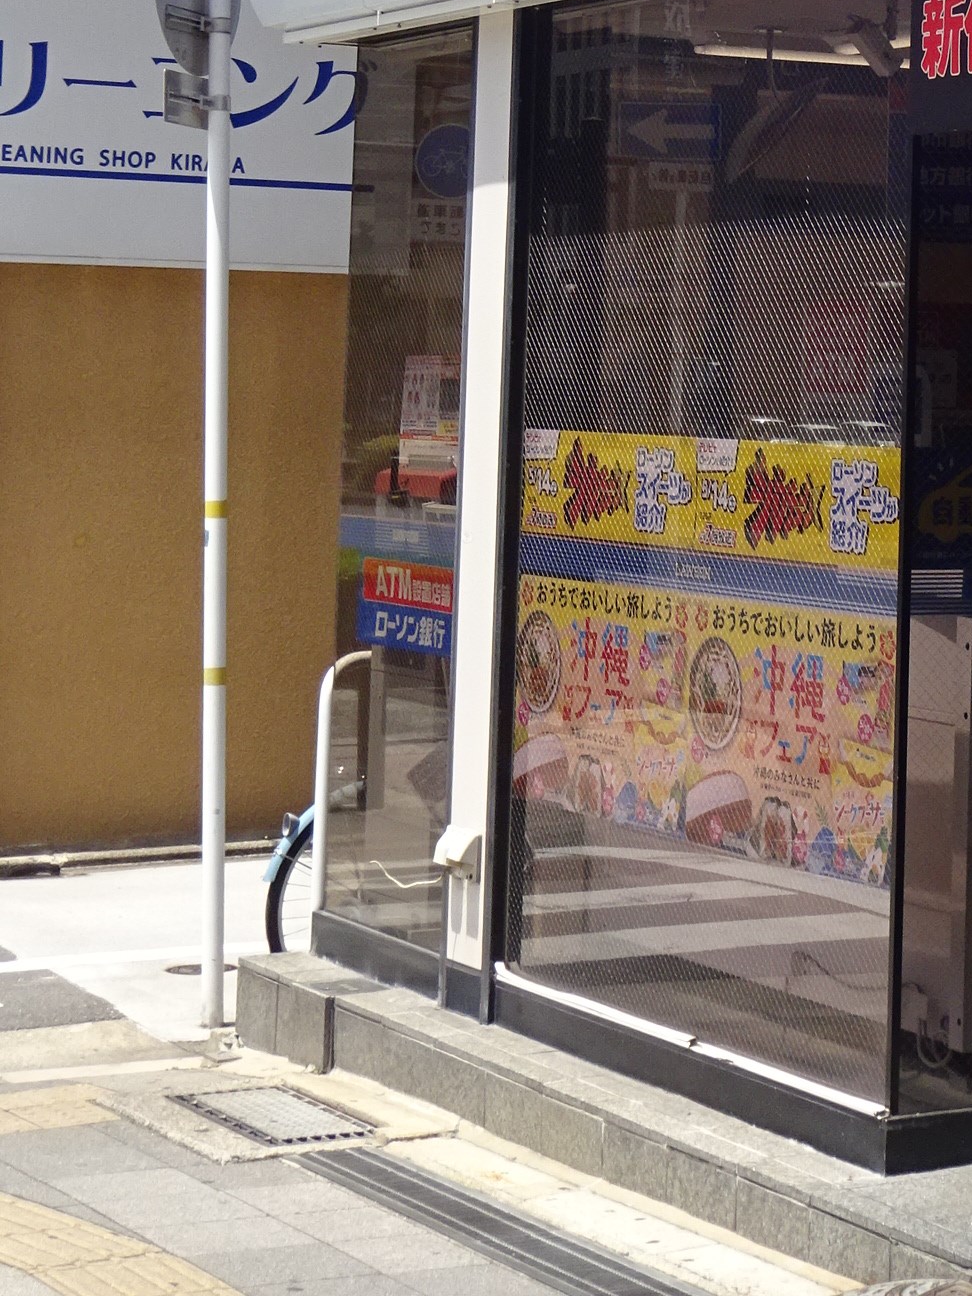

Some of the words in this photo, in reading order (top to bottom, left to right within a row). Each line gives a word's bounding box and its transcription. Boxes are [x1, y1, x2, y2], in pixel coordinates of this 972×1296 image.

[0, 38, 377, 136] リーング
[99, 149, 156, 169] SHOP
[374, 610, 446, 649] ローソン銀行
[570, 616, 631, 686] 沖縄
[711, 607, 877, 653] おうちでおいしい旅しよう
[752, 643, 827, 724] 沖縄
